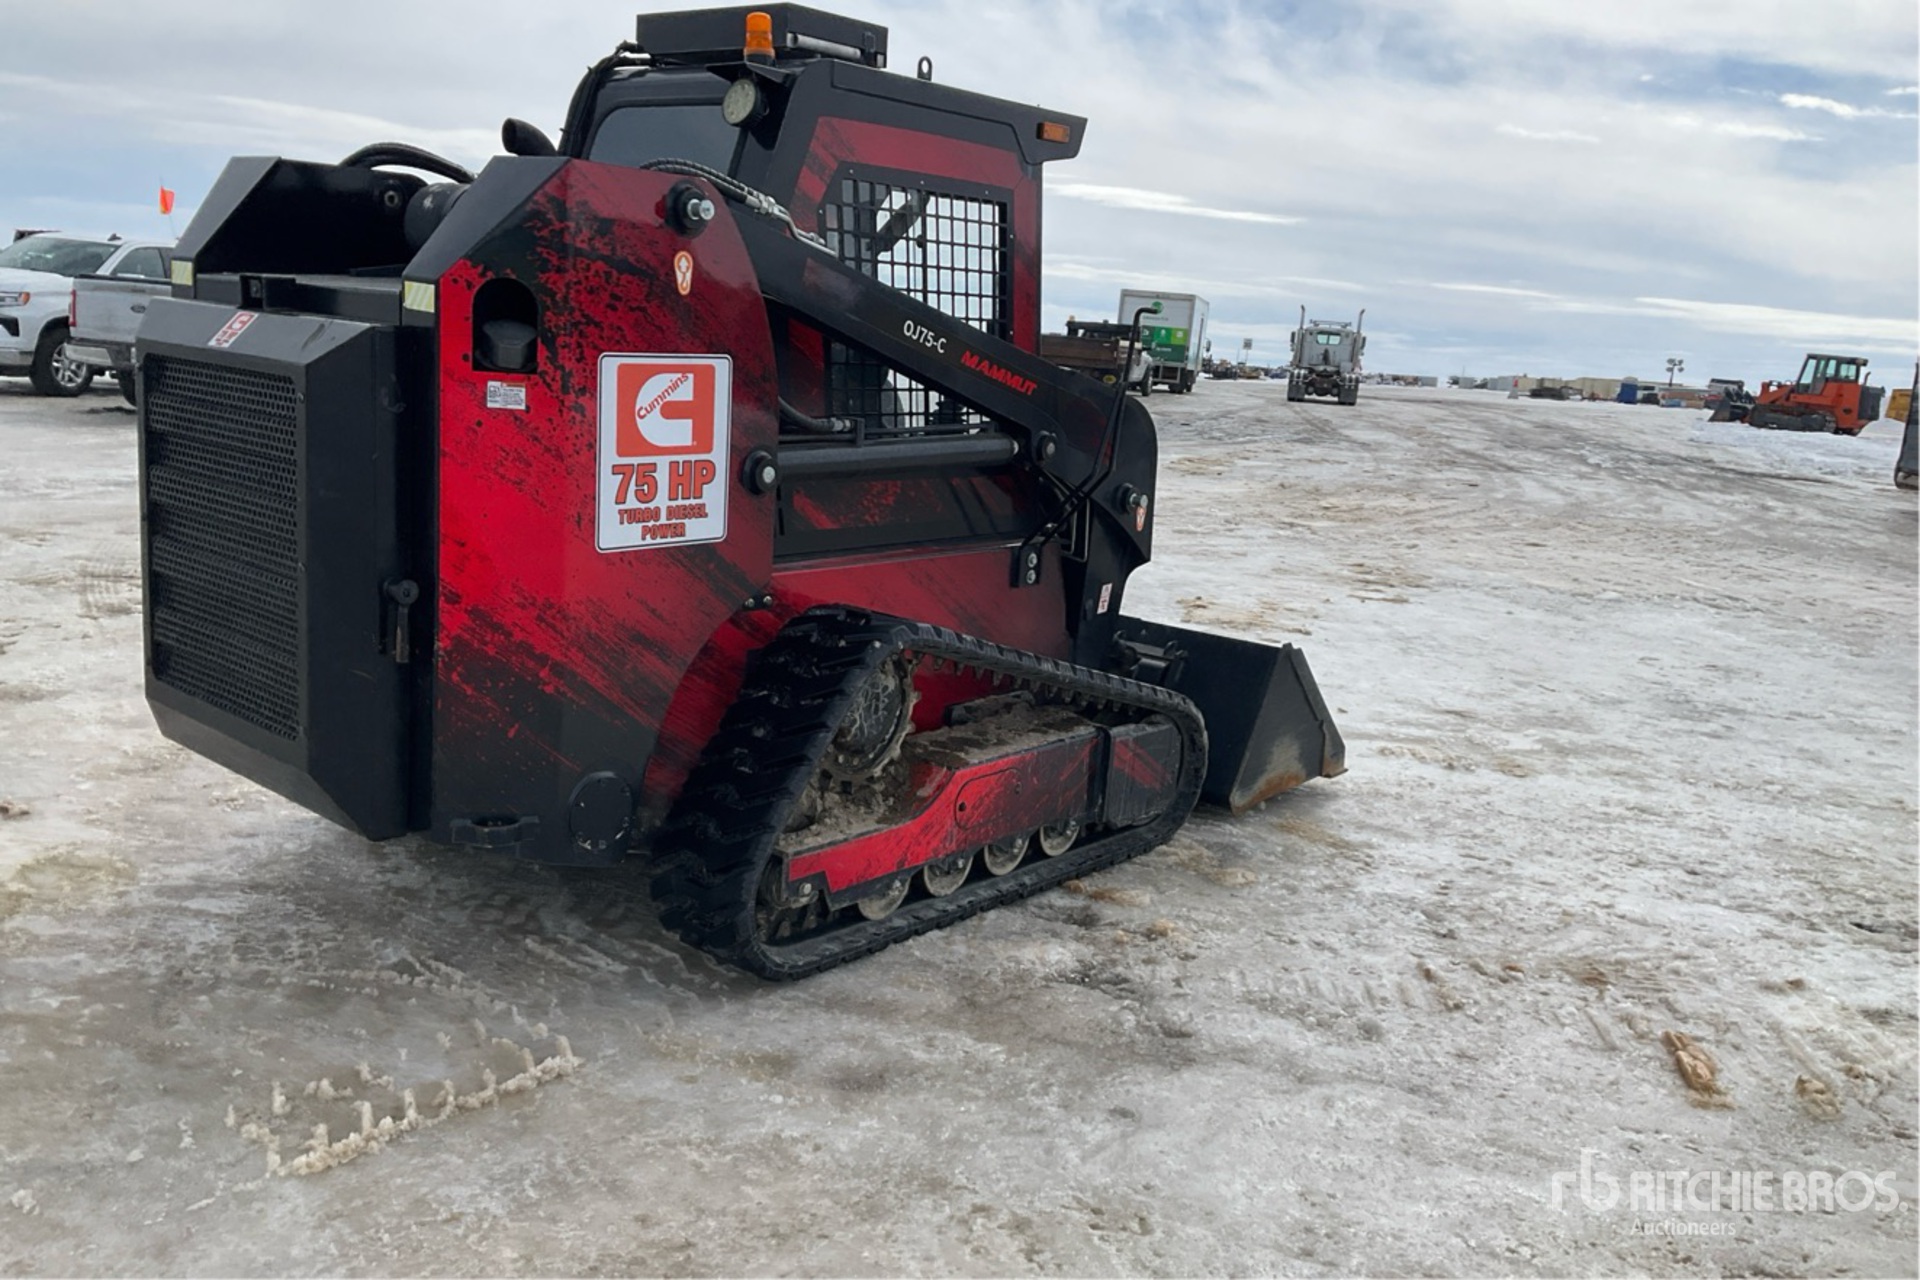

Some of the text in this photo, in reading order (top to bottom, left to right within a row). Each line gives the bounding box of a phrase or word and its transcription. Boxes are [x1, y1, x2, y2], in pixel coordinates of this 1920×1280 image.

[961, 350, 1037, 395] MAMMUT
[636, 372, 690, 420] Cummins
[612, 459, 716, 505] 75 HP
[618, 503, 708, 525] TURBO DIESEL
[641, 522, 686, 541] POWER
